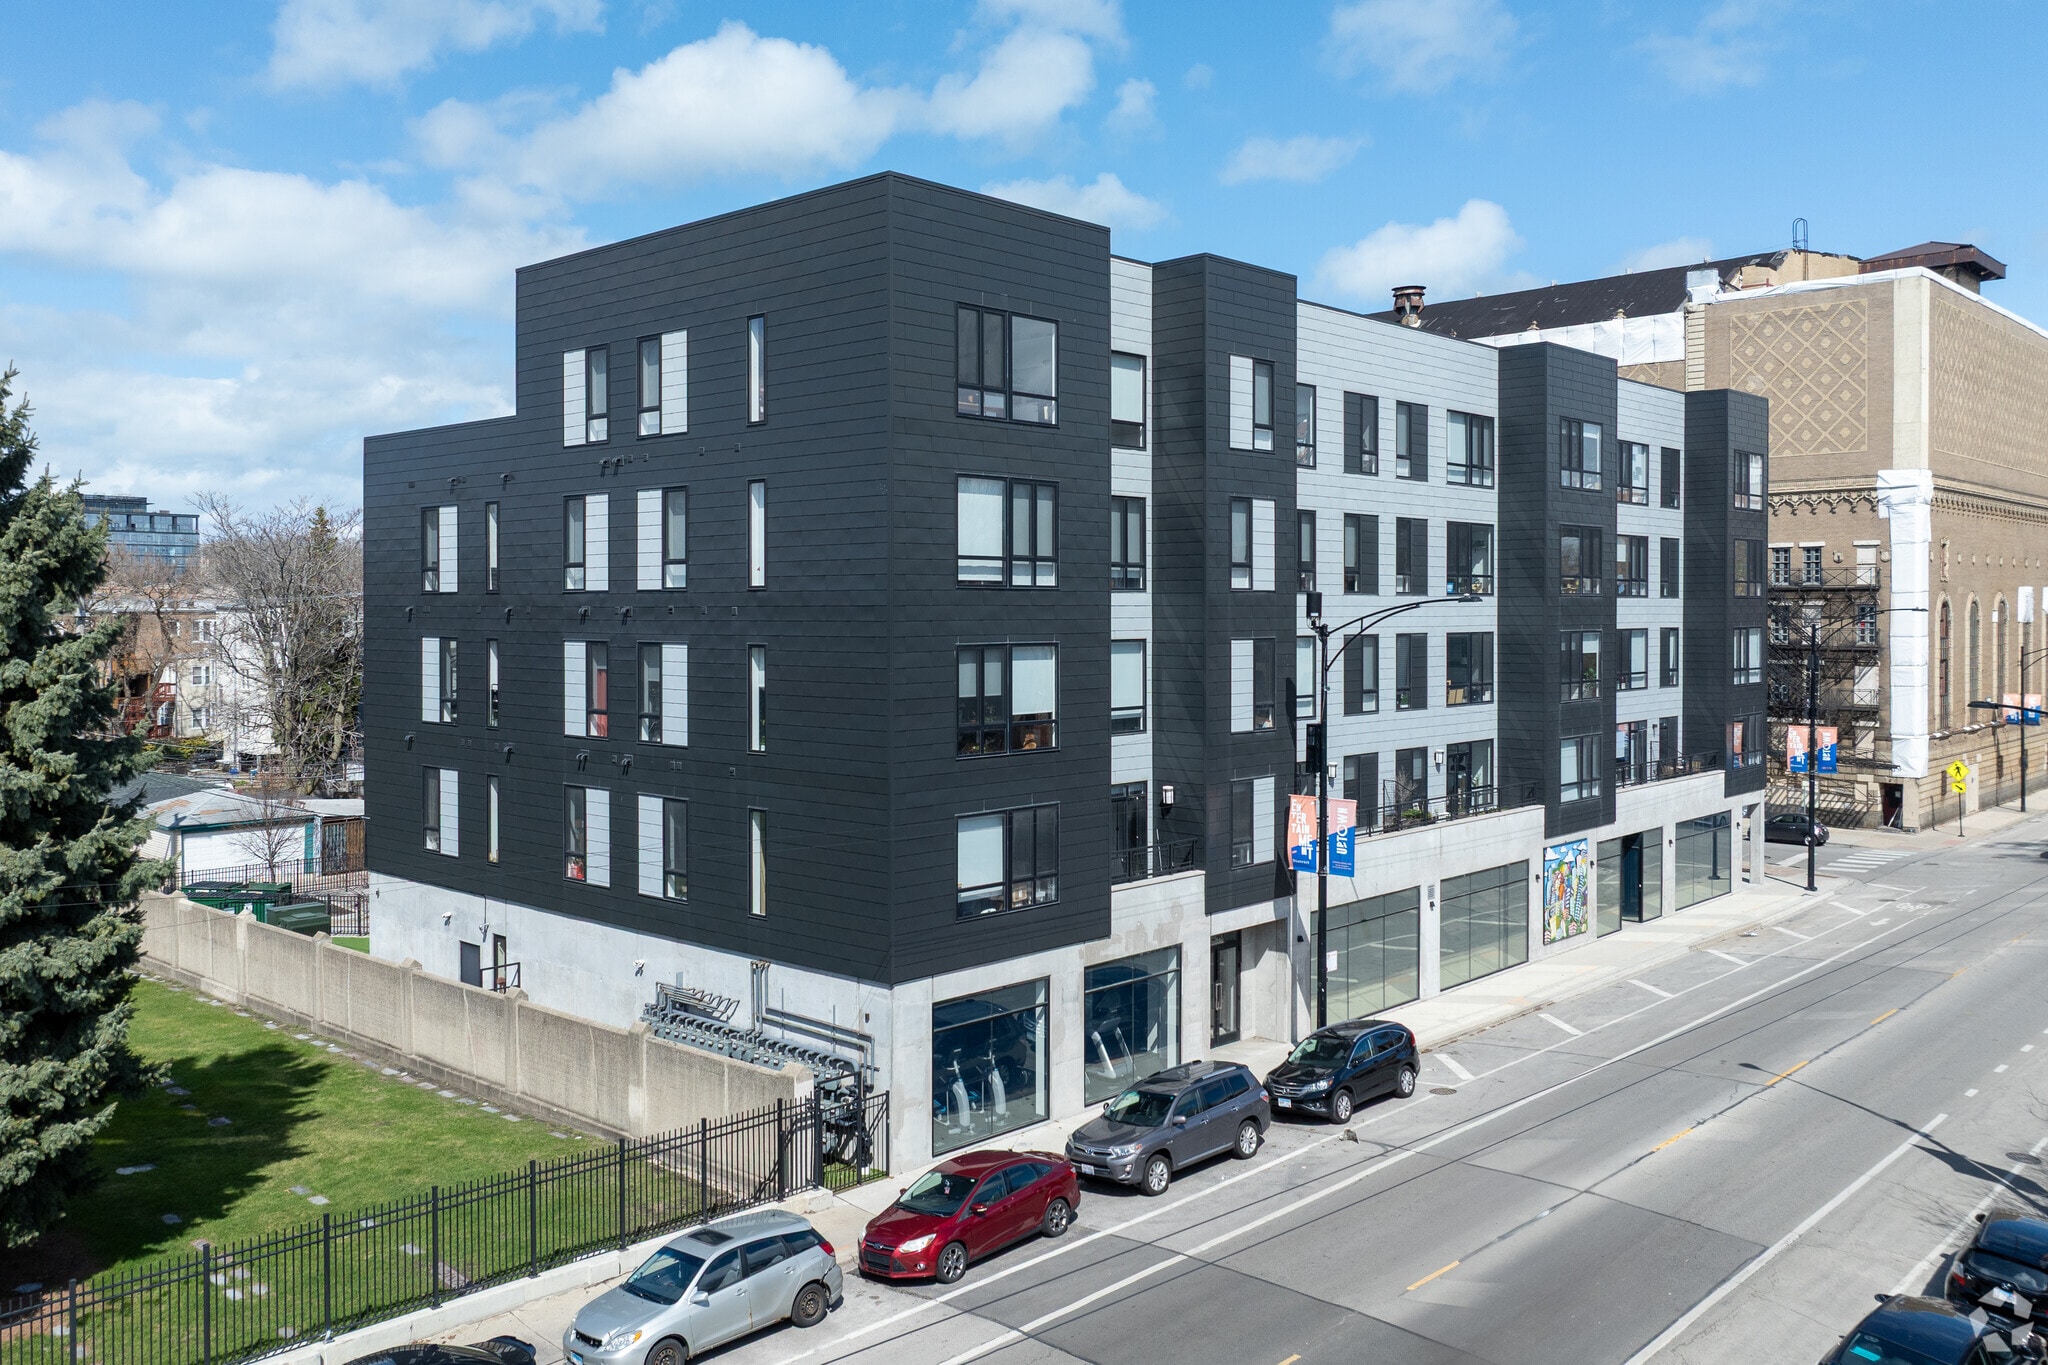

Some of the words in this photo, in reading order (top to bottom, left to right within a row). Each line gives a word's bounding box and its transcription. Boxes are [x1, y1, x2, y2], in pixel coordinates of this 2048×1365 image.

[1291, 812, 1307, 824] TER
[1291, 824, 1310, 834] TAIN
[1336, 807, 1348, 854] UPTOWN
[1298, 834, 1313, 847] ME
[1302, 847, 1313, 860] NT
